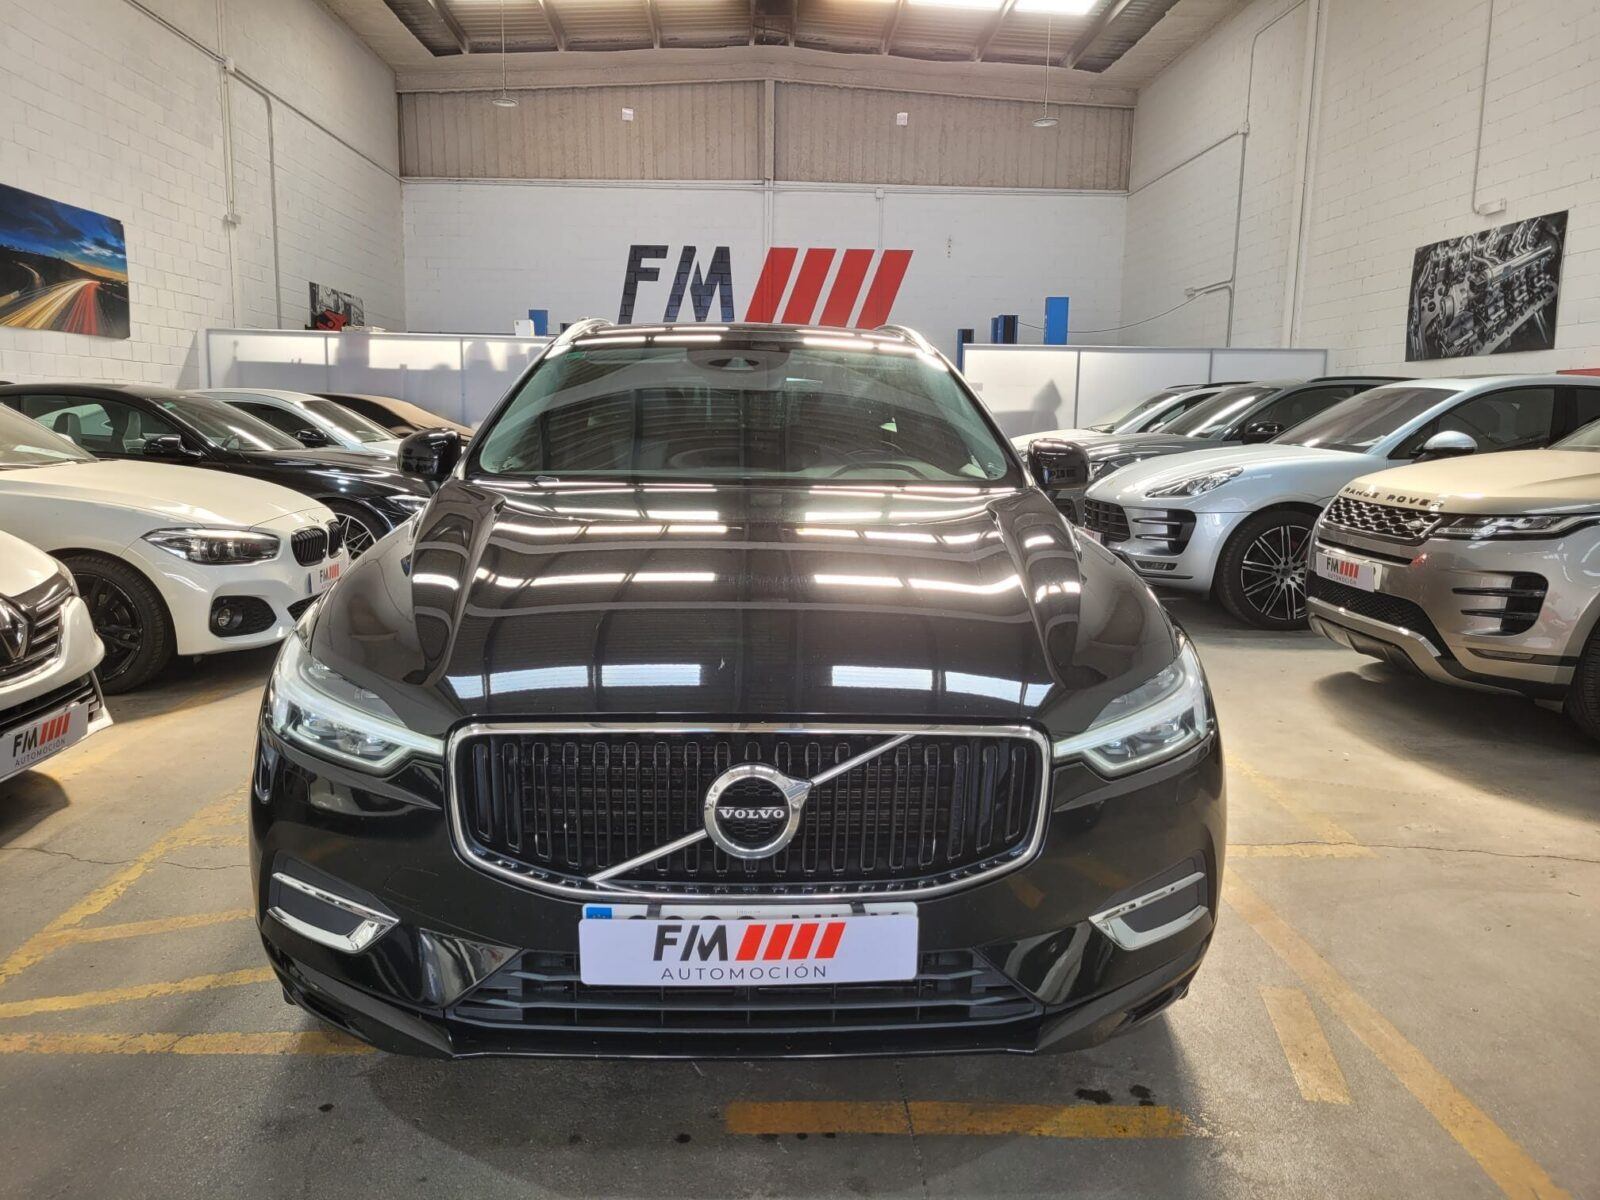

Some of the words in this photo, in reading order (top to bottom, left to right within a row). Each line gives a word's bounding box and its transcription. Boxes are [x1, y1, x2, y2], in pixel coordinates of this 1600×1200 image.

[617, 245, 735, 324] FM
[1344, 487, 1380, 499] RANGE
[1326, 556, 1339, 574] FM
[13, 727, 38, 758] FM
[719, 809, 785, 819] VOLVO
[653, 925, 729, 962] FM
[661, 963, 827, 981] AUTOMOCIÓN
